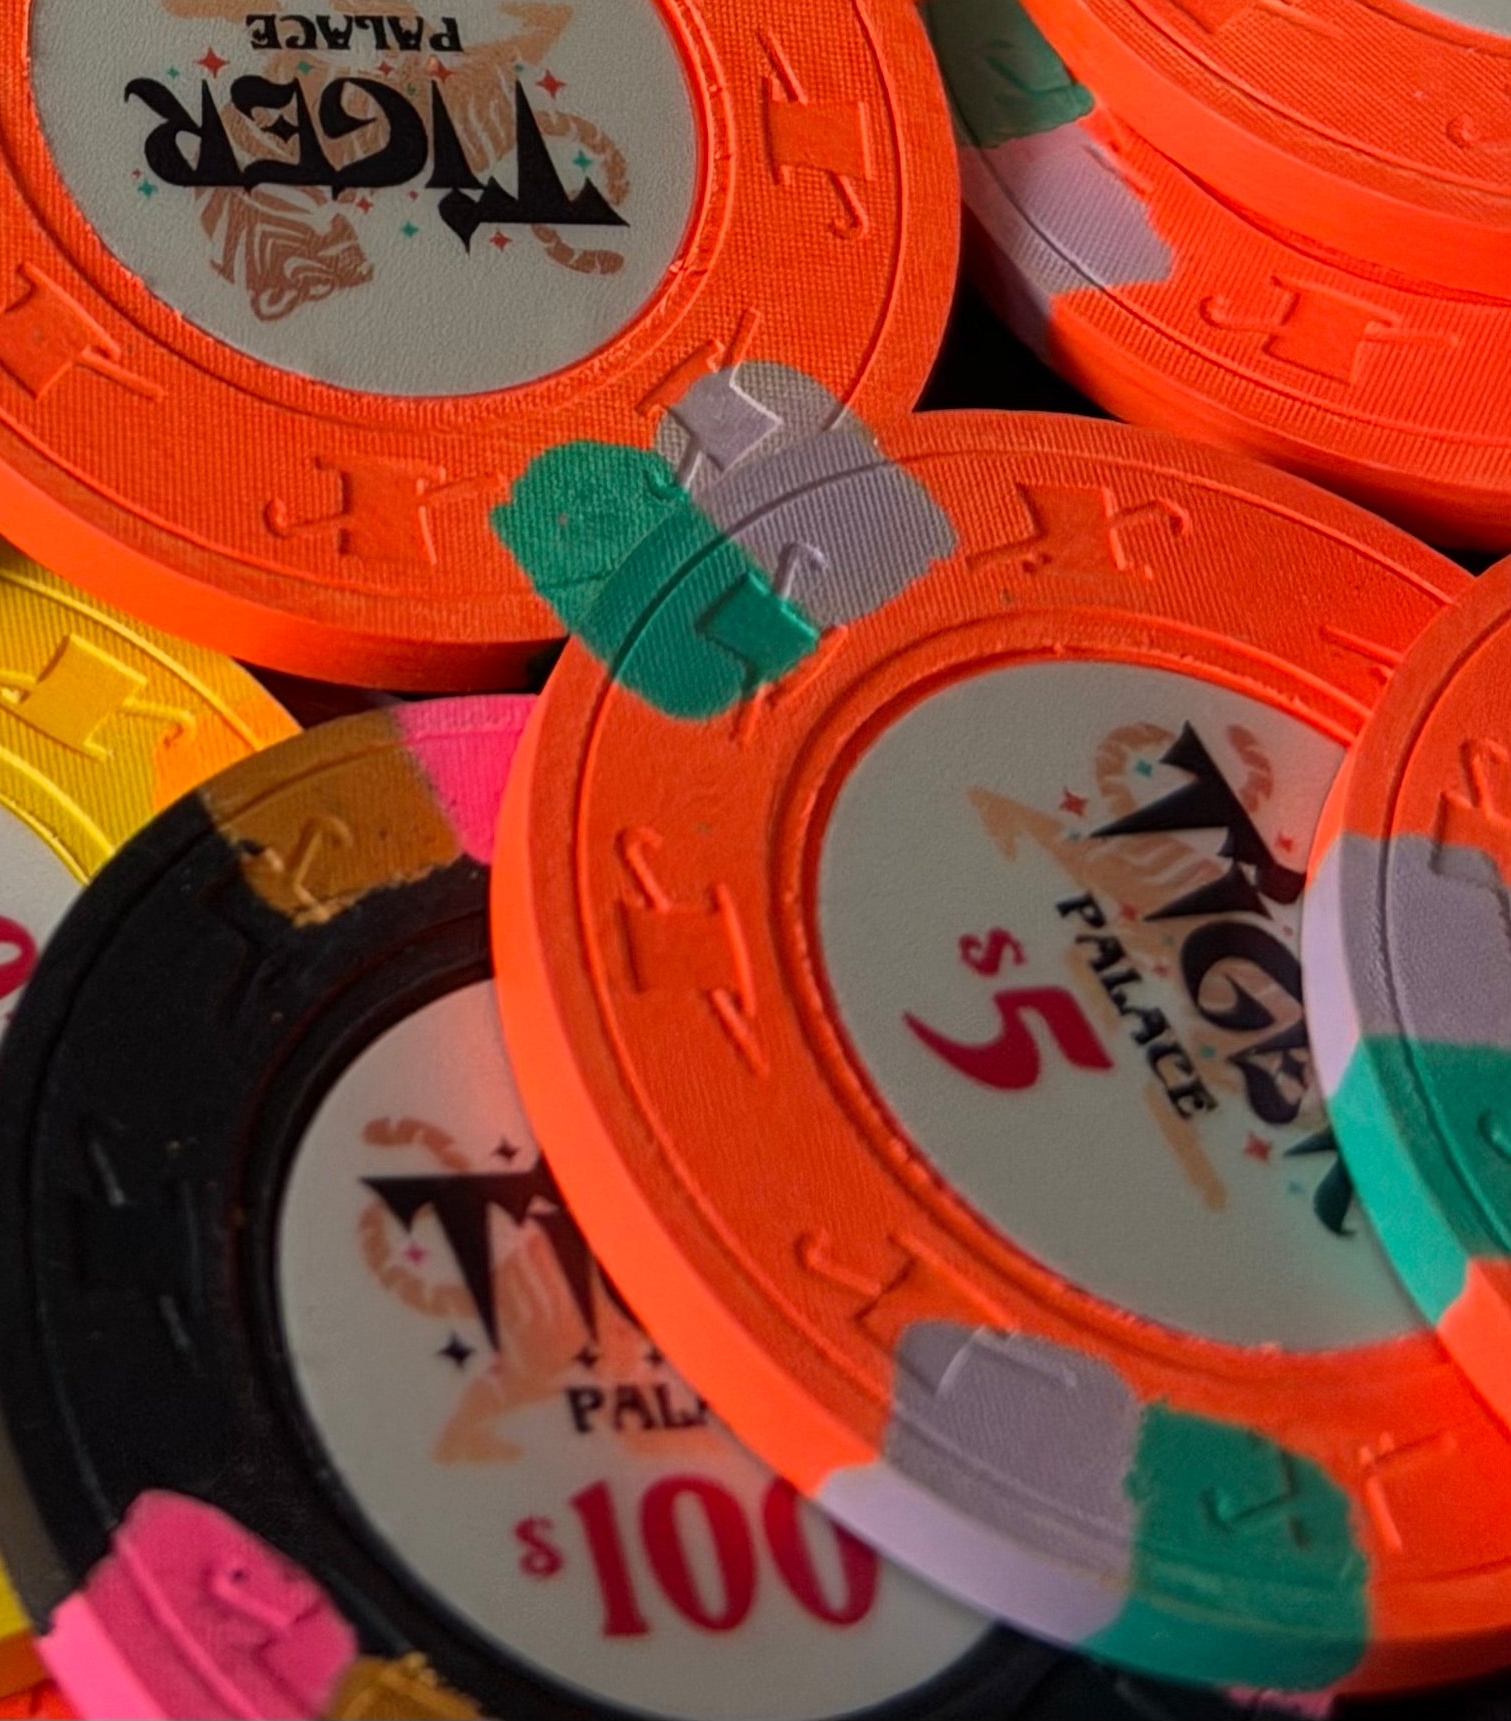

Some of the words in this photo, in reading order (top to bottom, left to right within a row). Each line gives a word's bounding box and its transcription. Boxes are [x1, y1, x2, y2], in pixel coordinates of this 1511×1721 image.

[246, 12, 464, 53] PALACE
[124, 74, 630, 254] TIGER
[904, 926, 1115, 1092] $5
[1057, 894, 1221, 1123] PALACE
[566, 1385, 712, 1435] PAL
[512, 1472, 882, 1638] $100
